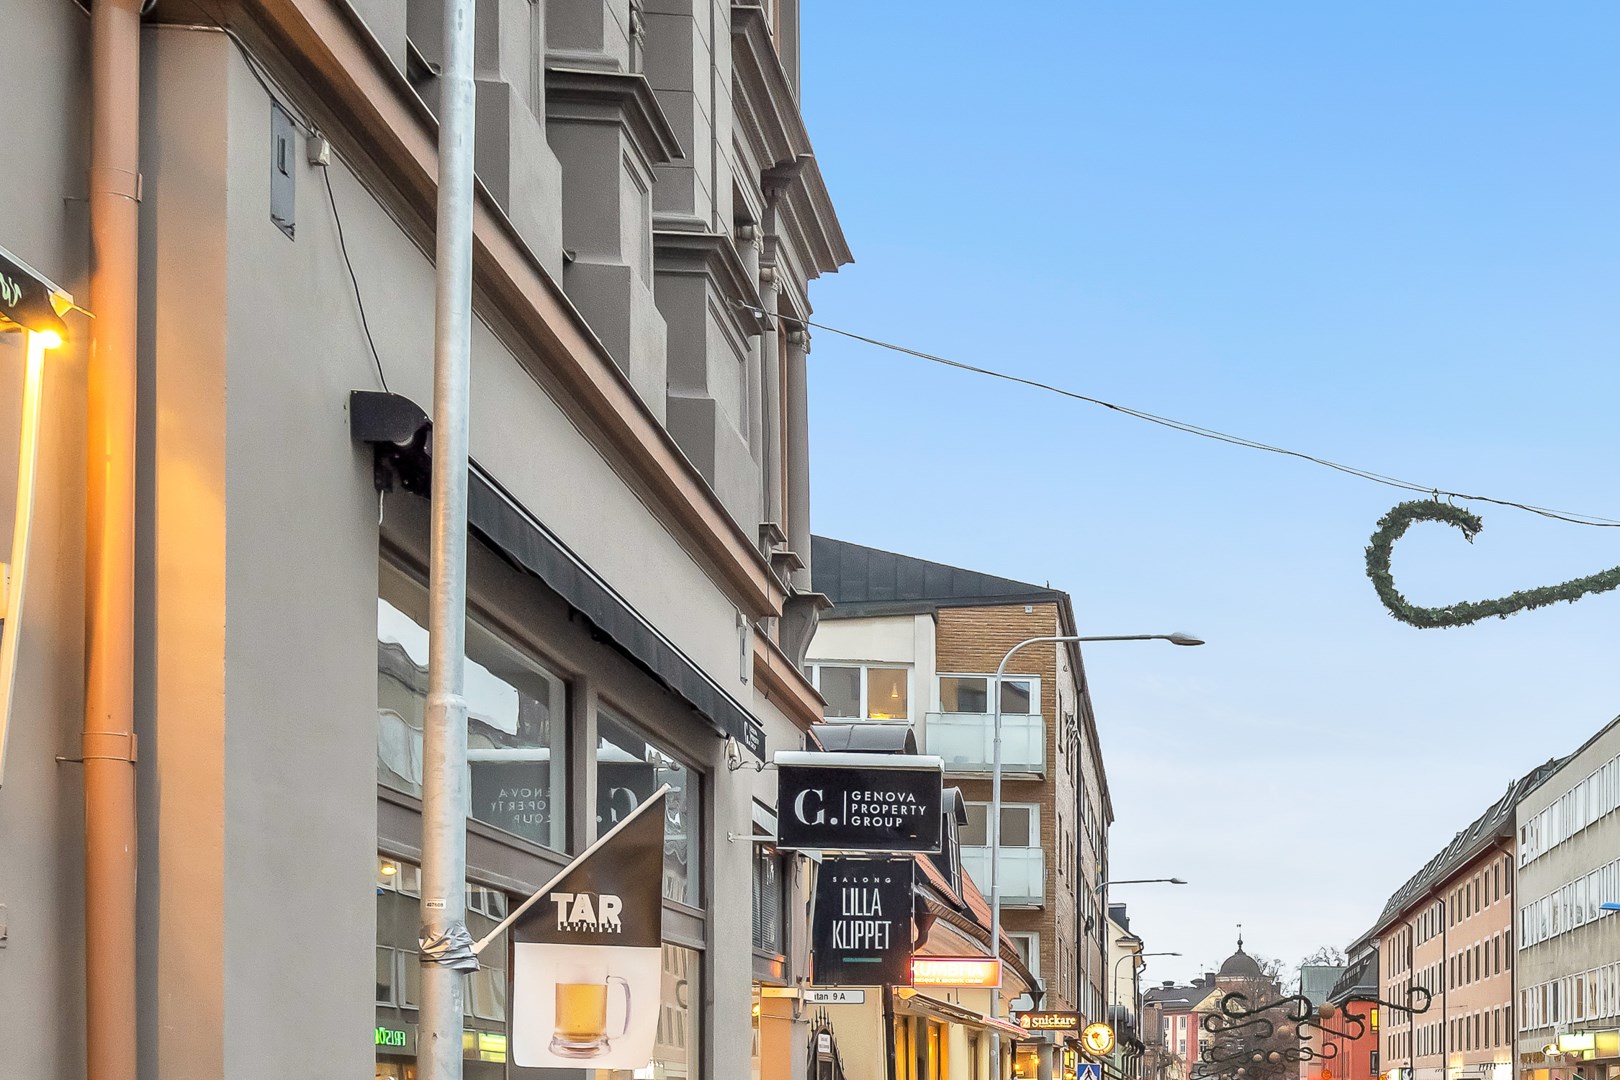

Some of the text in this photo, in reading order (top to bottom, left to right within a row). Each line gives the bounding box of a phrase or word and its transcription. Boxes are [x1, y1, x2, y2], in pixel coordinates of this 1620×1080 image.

[851, 791, 916, 802] GENOVA
[851, 803, 927, 815] PROPERTY
[851, 816, 903, 827] GROUP
[842, 887, 882, 916] LILLA
[550, 892, 623, 927] TAR
[832, 920, 892, 950] KLIPPET
[832, 992, 838, 1000] 9
[839, 992, 846, 1000] A
